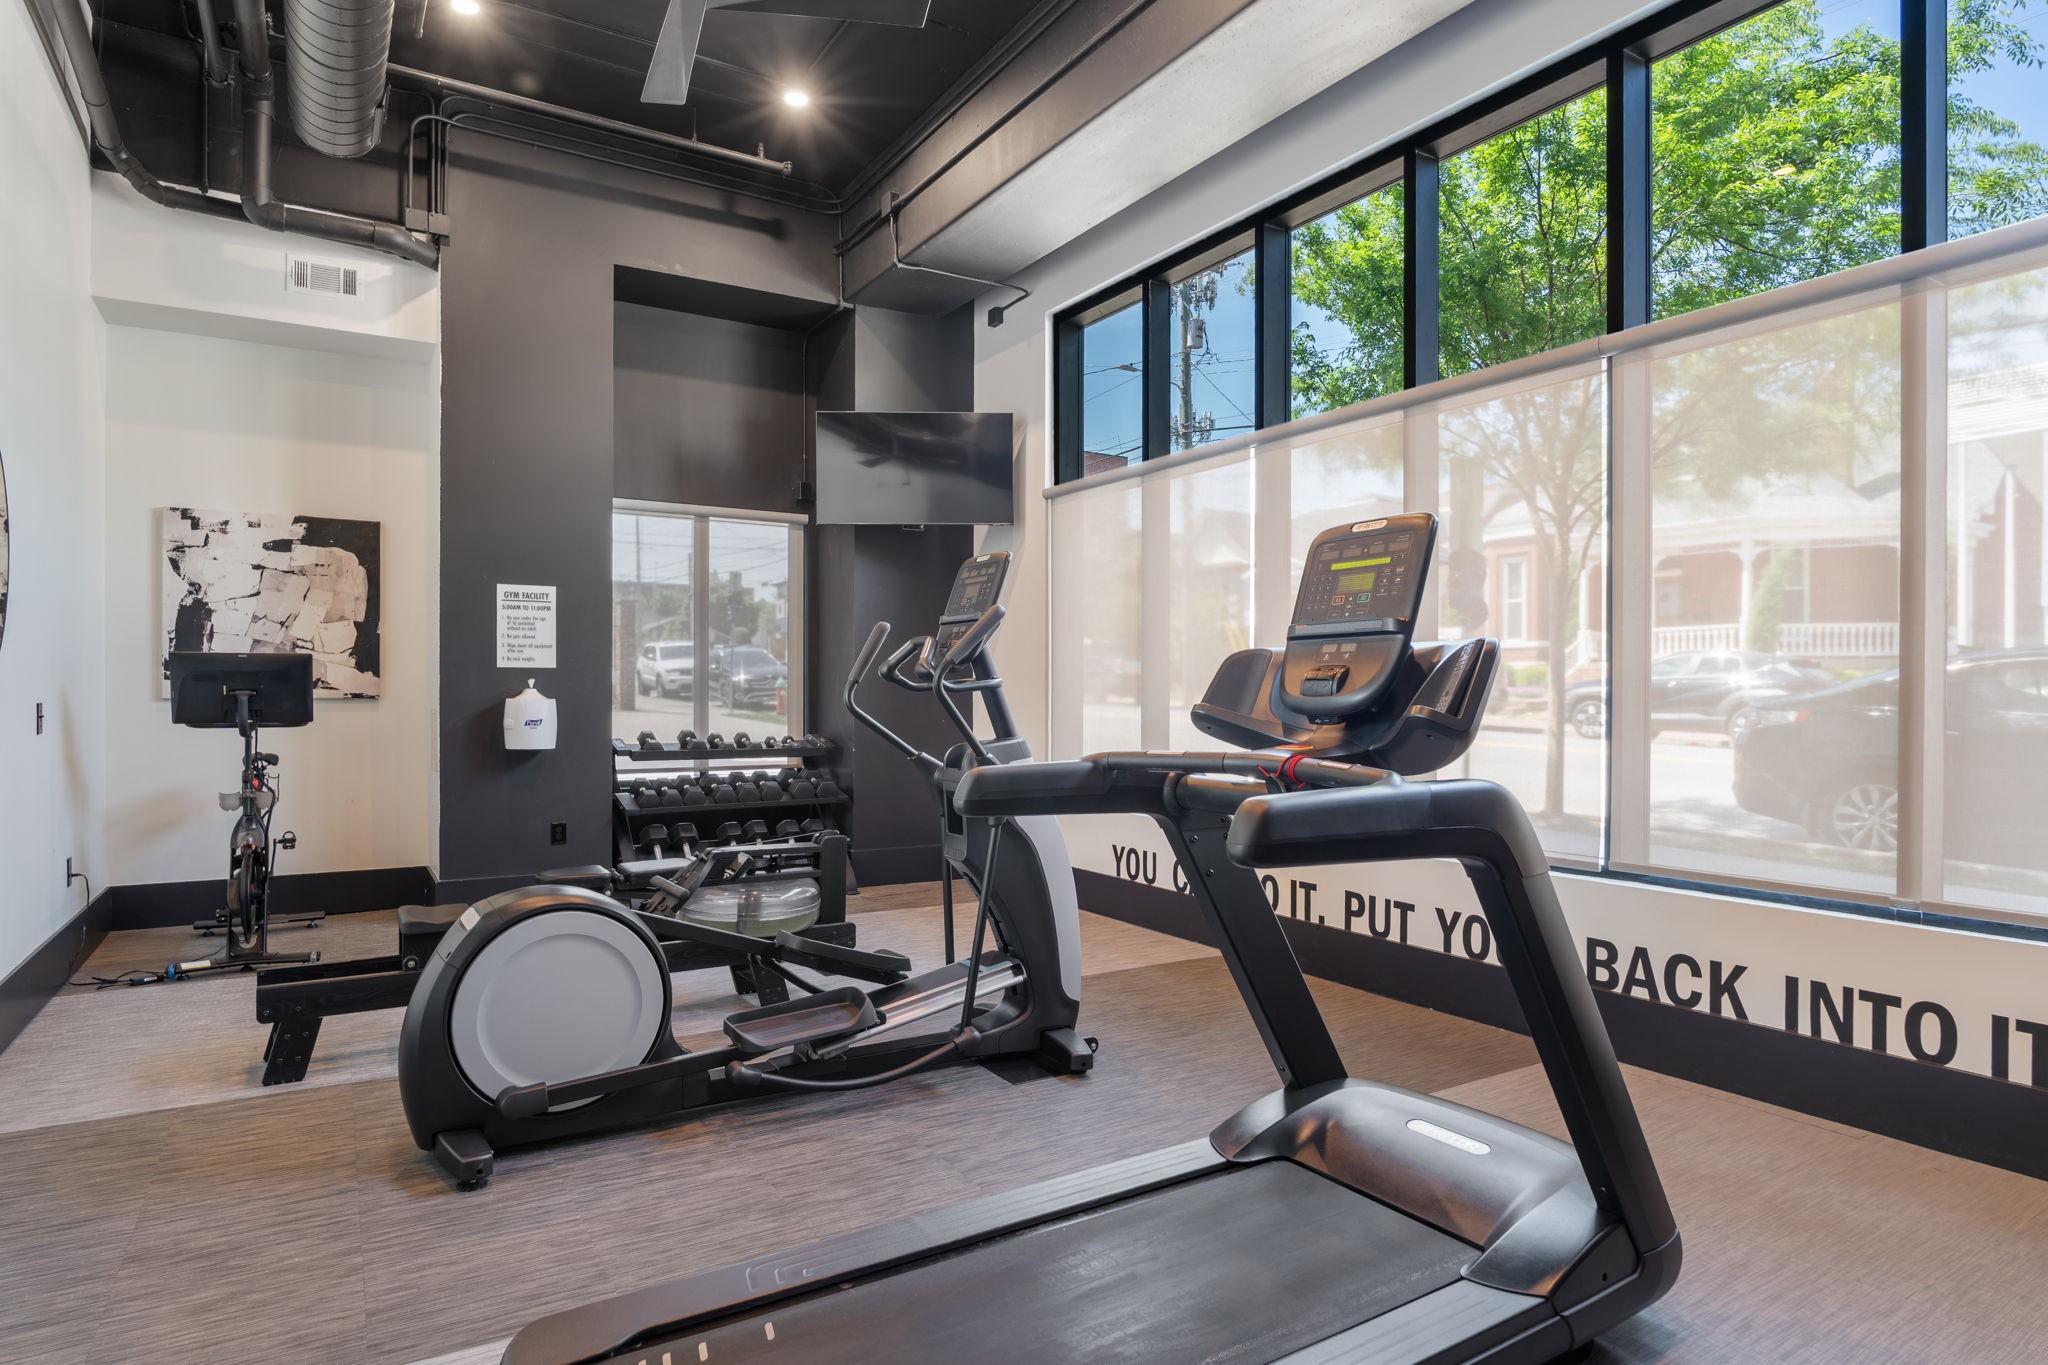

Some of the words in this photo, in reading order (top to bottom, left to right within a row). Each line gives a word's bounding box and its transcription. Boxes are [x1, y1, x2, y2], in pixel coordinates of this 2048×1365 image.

[504, 591, 520, 599] GYM
[522, 592, 550, 600] FACILITY
[1112, 844, 1156, 885] YOU
[1261, 874, 1280, 914] O
[1345, 890, 1415, 945] PUT
[1587, 937, 1749, 1021] BACK
[1785, 975, 1958, 1067] INTO
